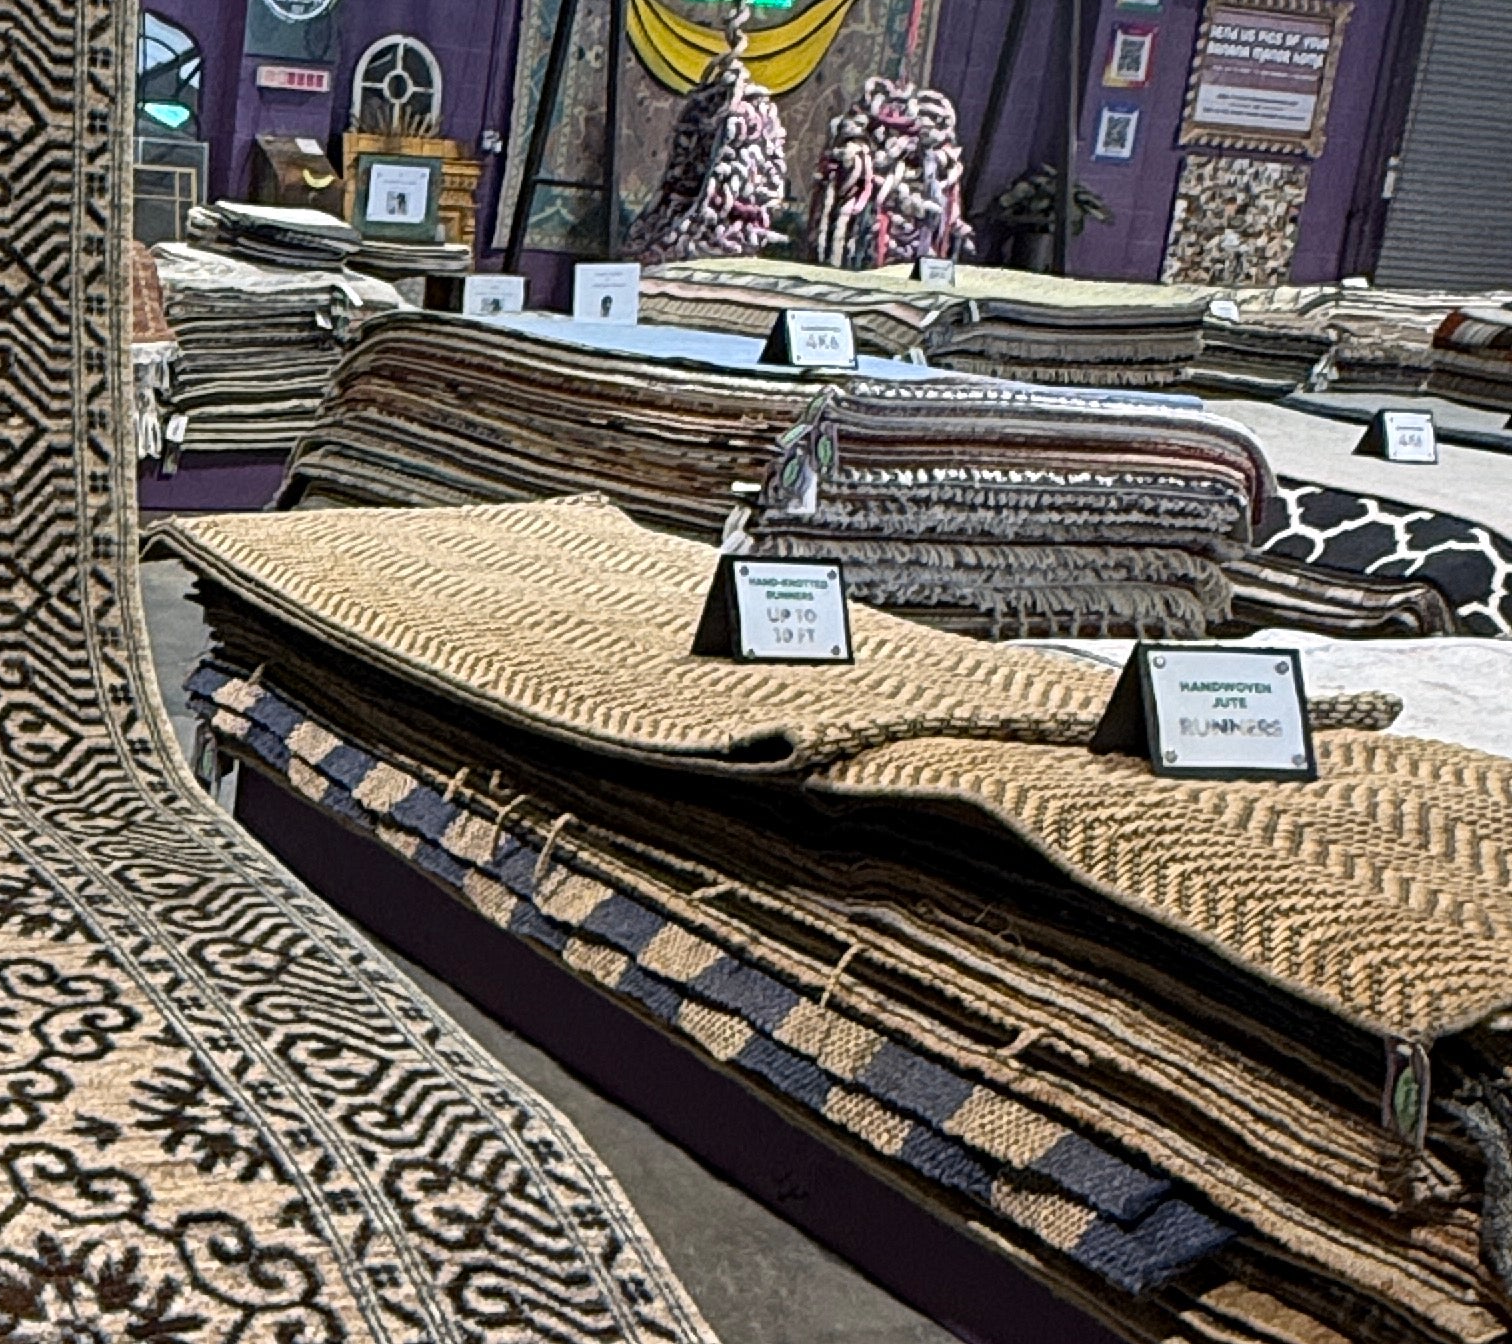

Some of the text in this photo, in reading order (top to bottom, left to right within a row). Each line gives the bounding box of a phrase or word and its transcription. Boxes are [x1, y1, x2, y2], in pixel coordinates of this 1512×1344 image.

[748, 578, 828, 589] HAND-KNOTTED
[767, 608, 817, 623] UP TO
[773, 627, 815, 644] 10 FT
[1179, 681, 1272, 693] HANDWOVEN
[1212, 697, 1248, 709] JUTE
[1179, 717, 1284, 738] RUNNERS
